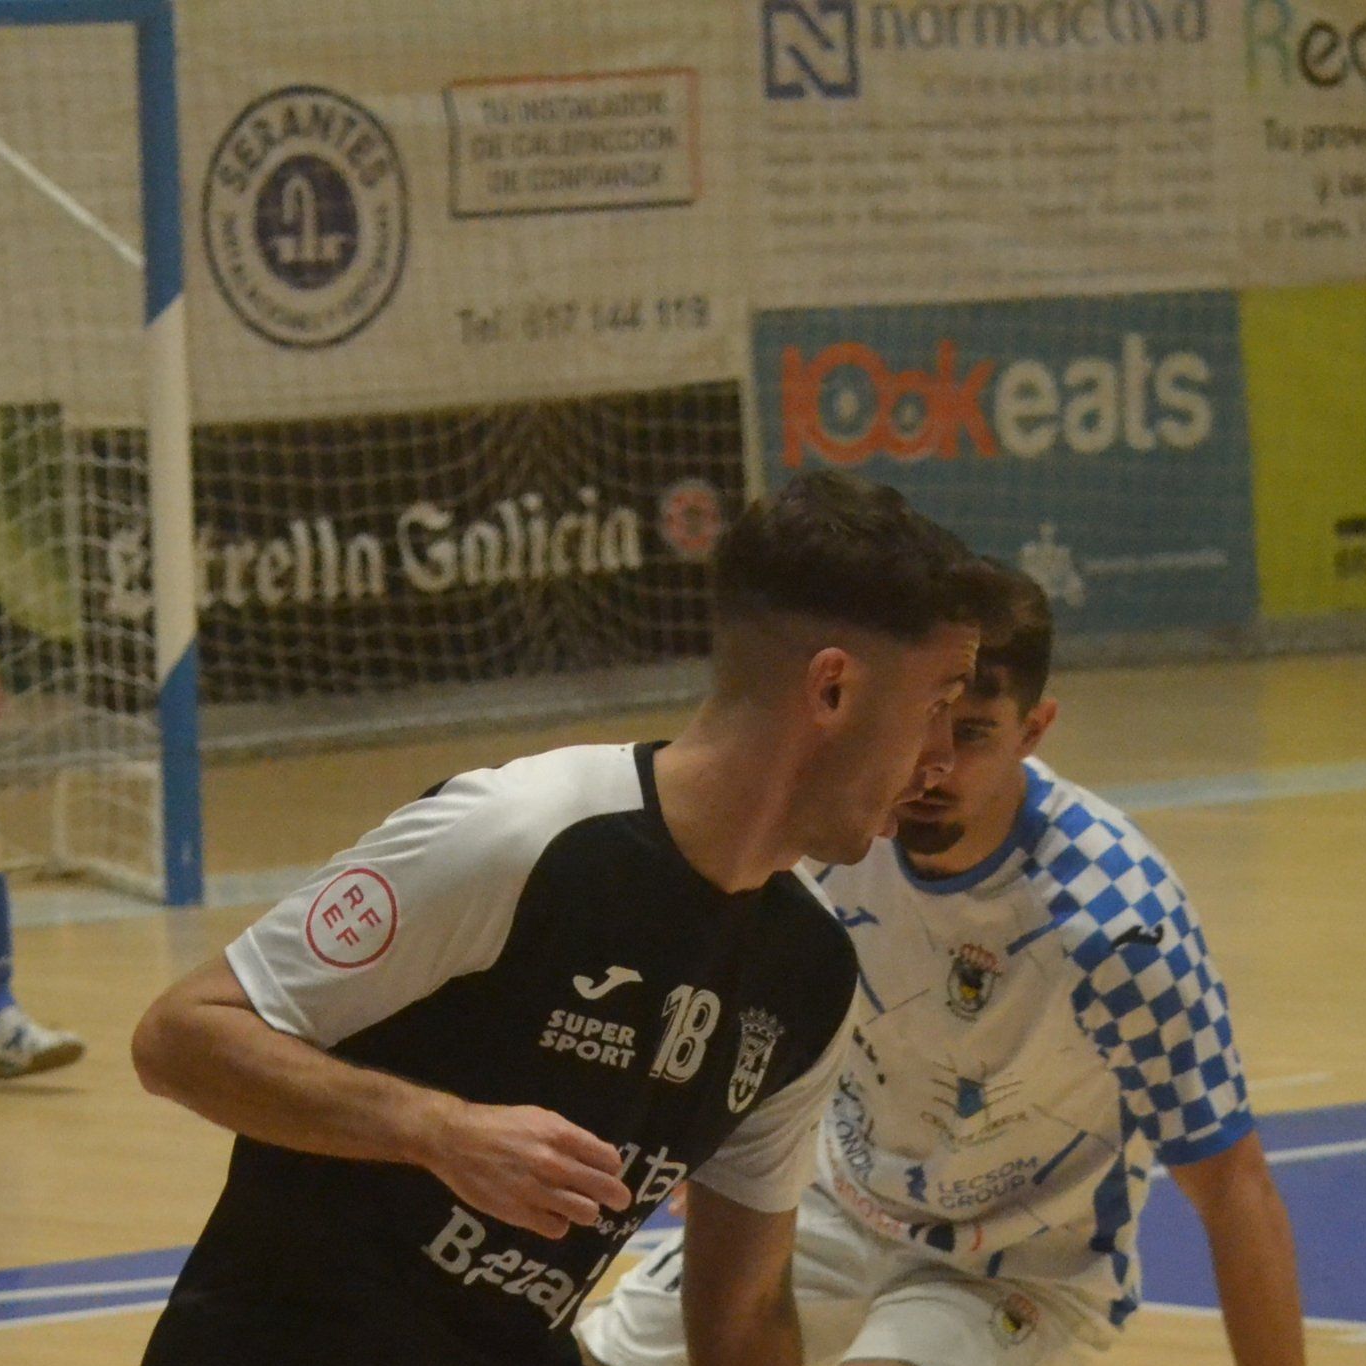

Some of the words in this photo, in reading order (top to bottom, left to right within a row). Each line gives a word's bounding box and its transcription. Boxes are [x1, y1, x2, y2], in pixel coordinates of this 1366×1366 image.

[396, 486, 643, 592] Galicia
[539, 1030, 636, 1070] SPORT
[547, 1009, 637, 1047] SUPER
[648, 984, 721, 1084] 18
